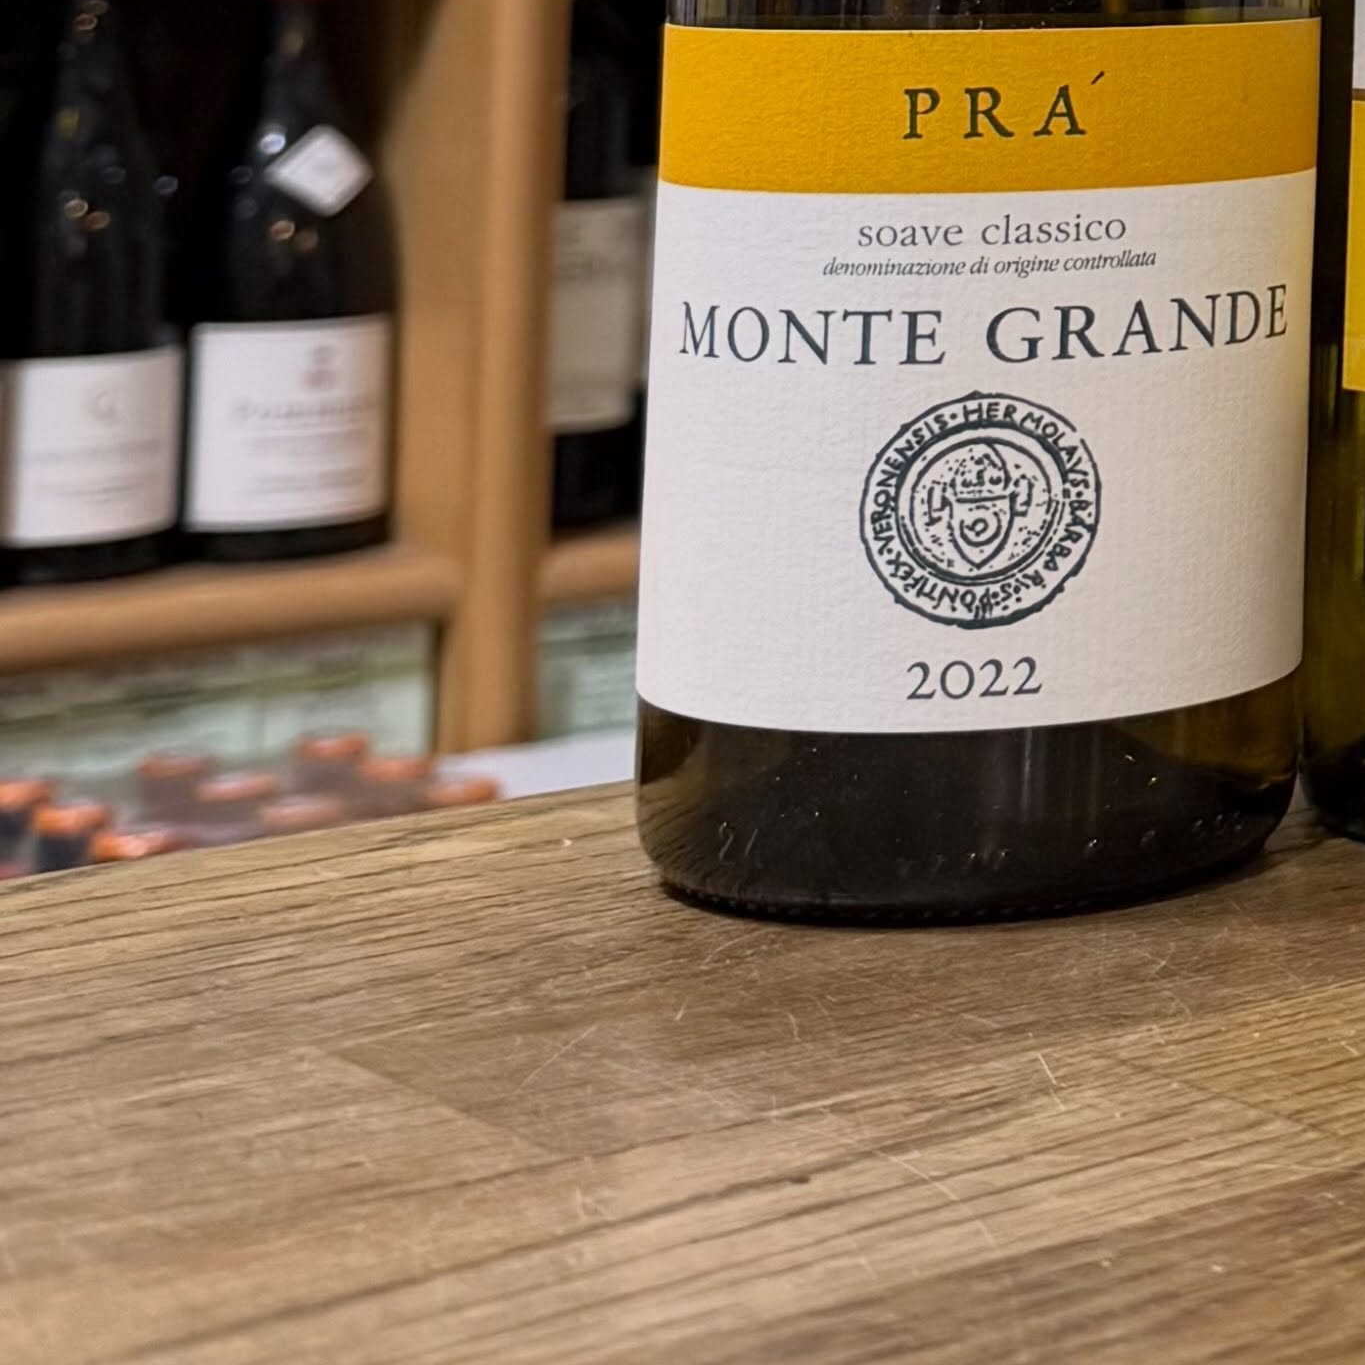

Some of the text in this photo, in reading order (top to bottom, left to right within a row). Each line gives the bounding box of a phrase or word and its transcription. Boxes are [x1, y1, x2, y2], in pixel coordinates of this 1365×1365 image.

[858, 214, 1127, 248] soave classico
[822, 248, 1156, 279] denominazione di origine controllata
[680, 283, 1288, 365] MONTE GRANDE
[906, 656, 1043, 701] 2022
